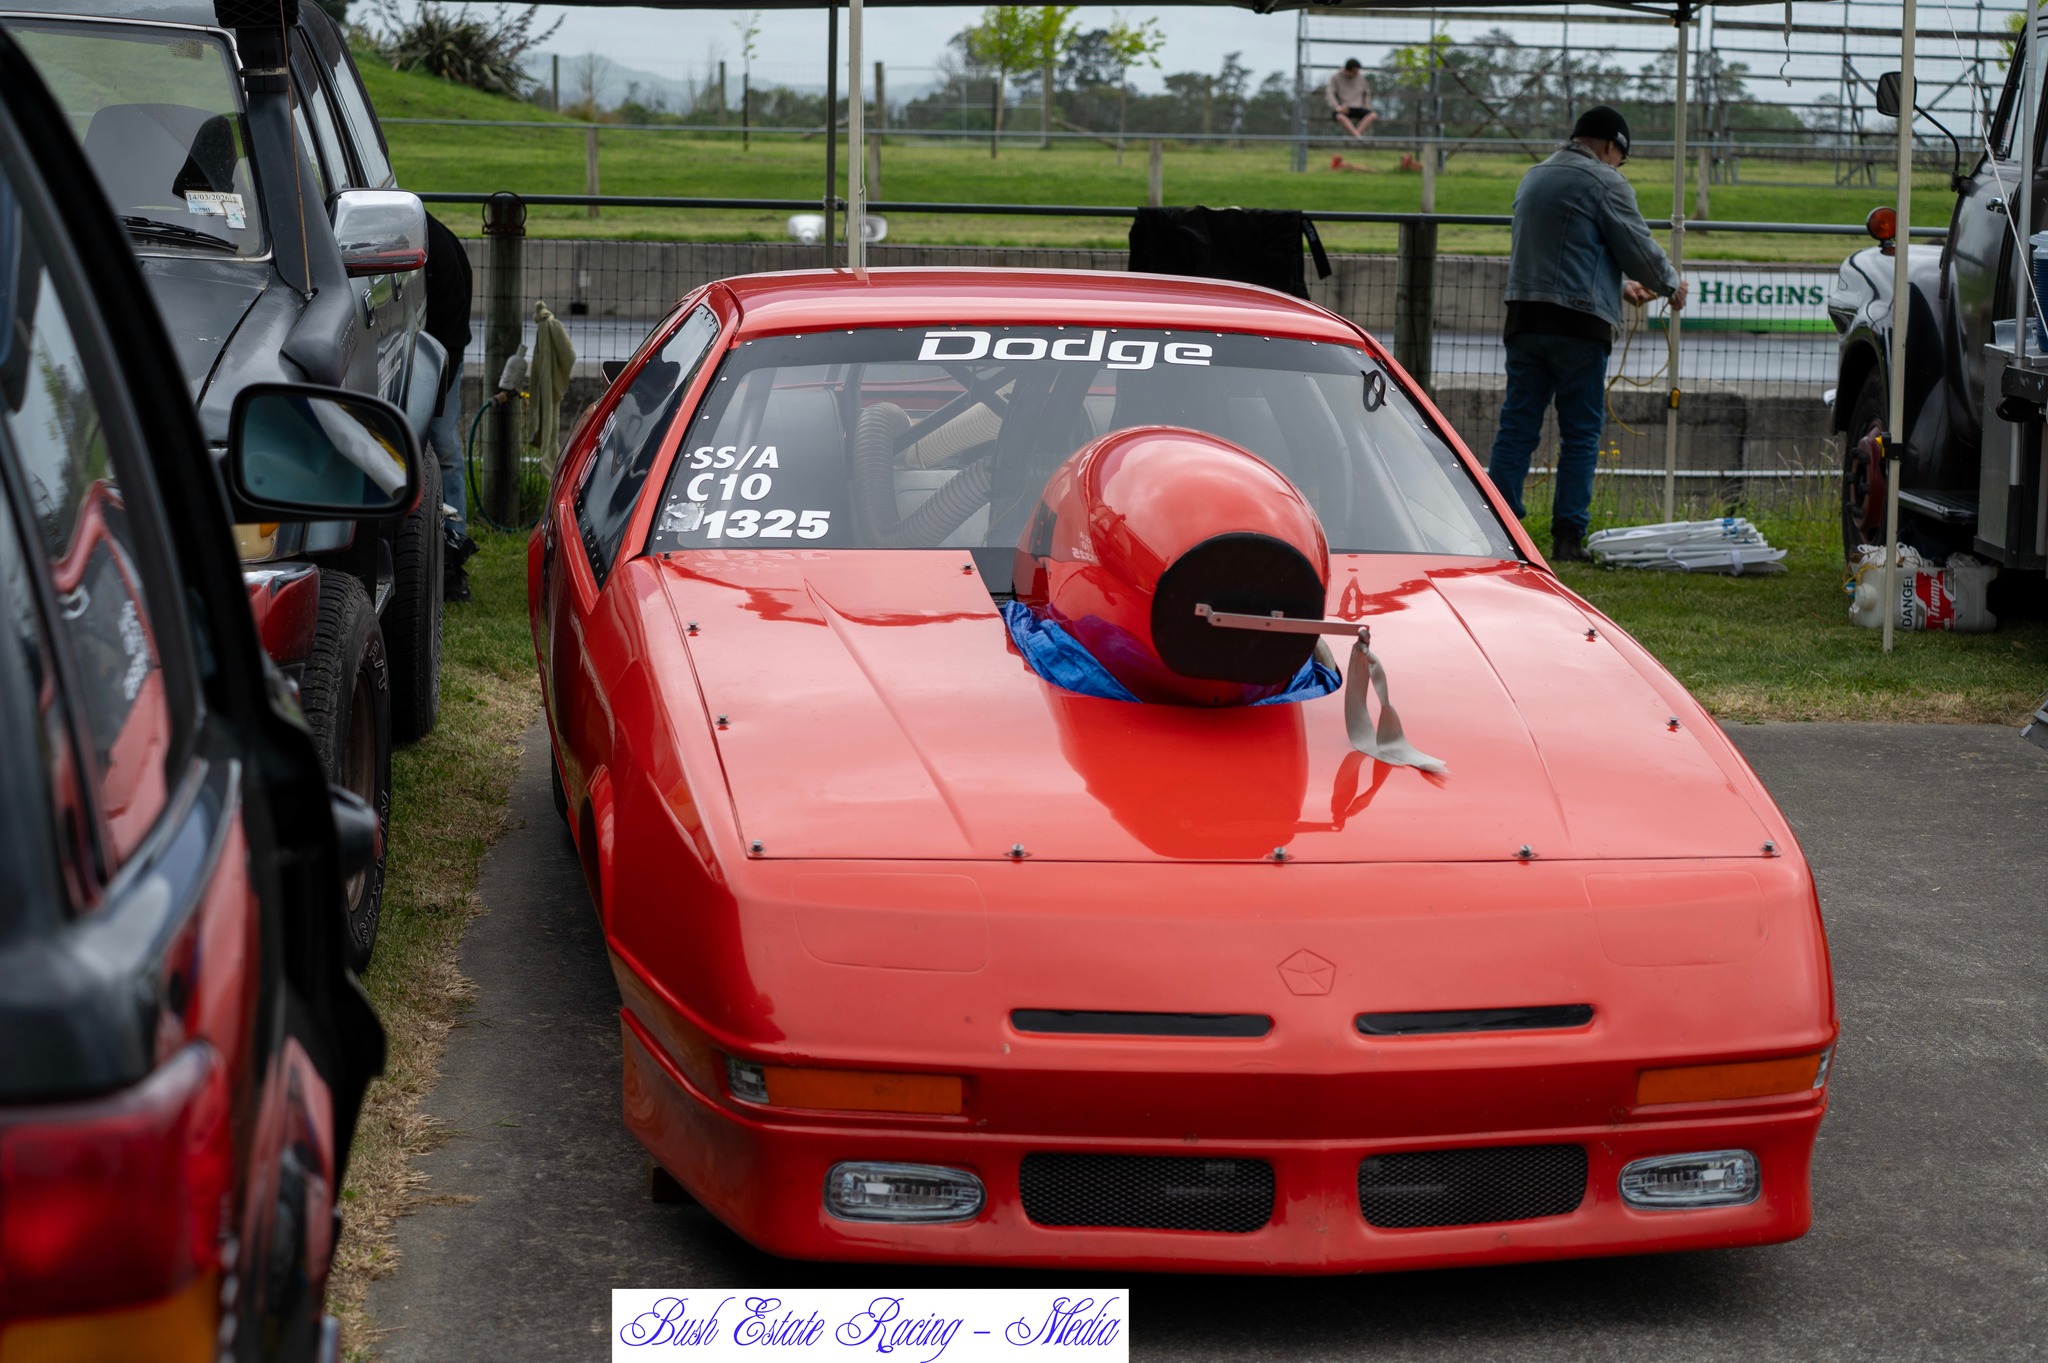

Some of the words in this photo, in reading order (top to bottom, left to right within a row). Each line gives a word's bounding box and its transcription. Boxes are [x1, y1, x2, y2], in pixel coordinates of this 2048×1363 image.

[1700, 280, 1824, 306] HIGGINS
[918, 330, 1213, 370] Dodge
[690, 446, 779, 471] SS/A
[702, 509, 831, 540] 1325
[1902, 576, 1914, 628] DANGE
[1927, 578, 1943, 618] Trump
